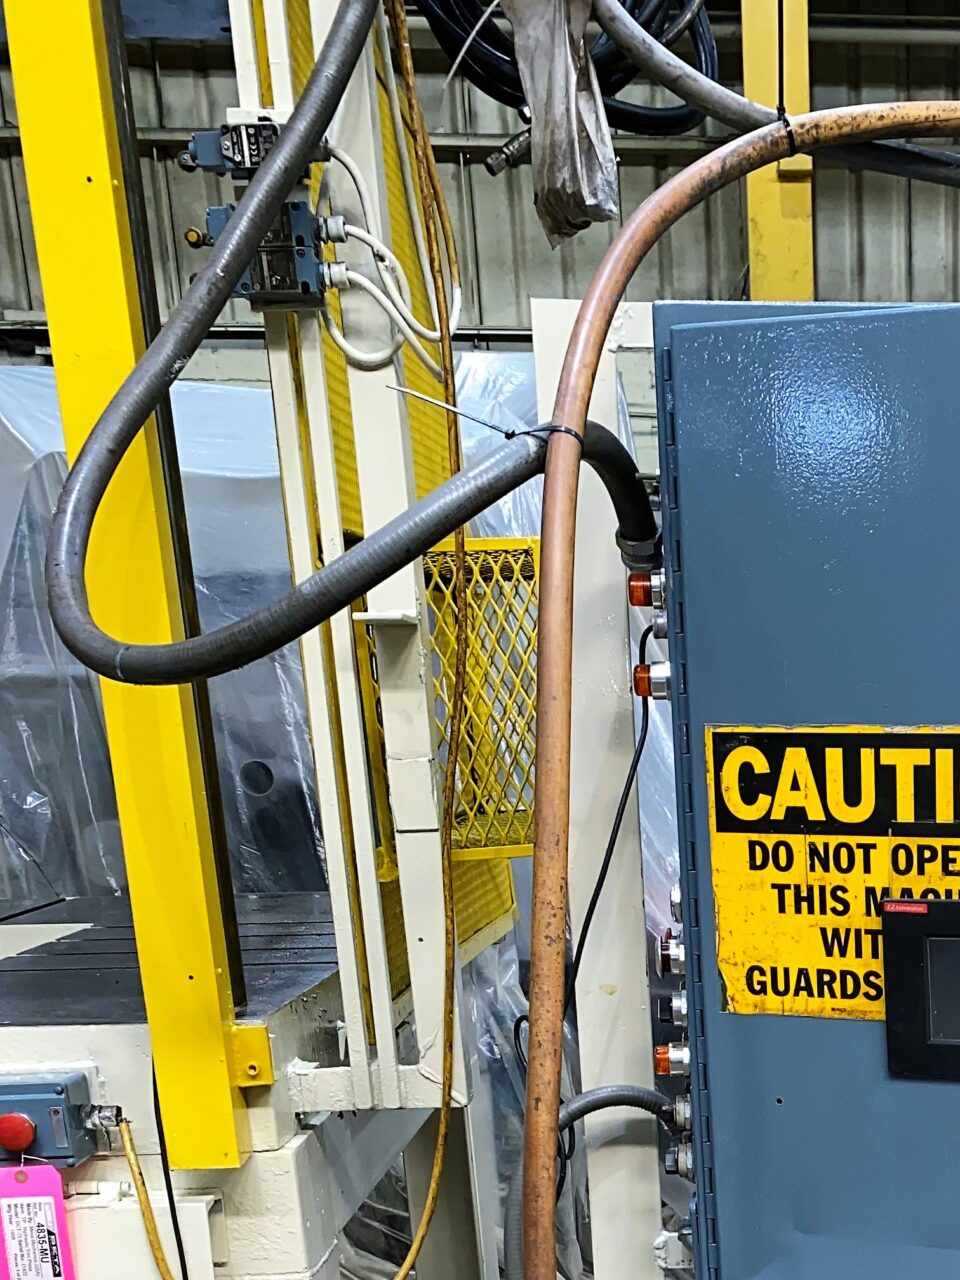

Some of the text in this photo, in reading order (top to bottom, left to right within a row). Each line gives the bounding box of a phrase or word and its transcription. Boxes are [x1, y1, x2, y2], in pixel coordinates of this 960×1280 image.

[748, 840, 794, 872] DO
[808, 842, 877, 874] NOT
[770, 883, 850, 917] THIS
[746, 965, 884, 1001] GUARDS
[36, 1222, 49, 1263] 4835-MU
